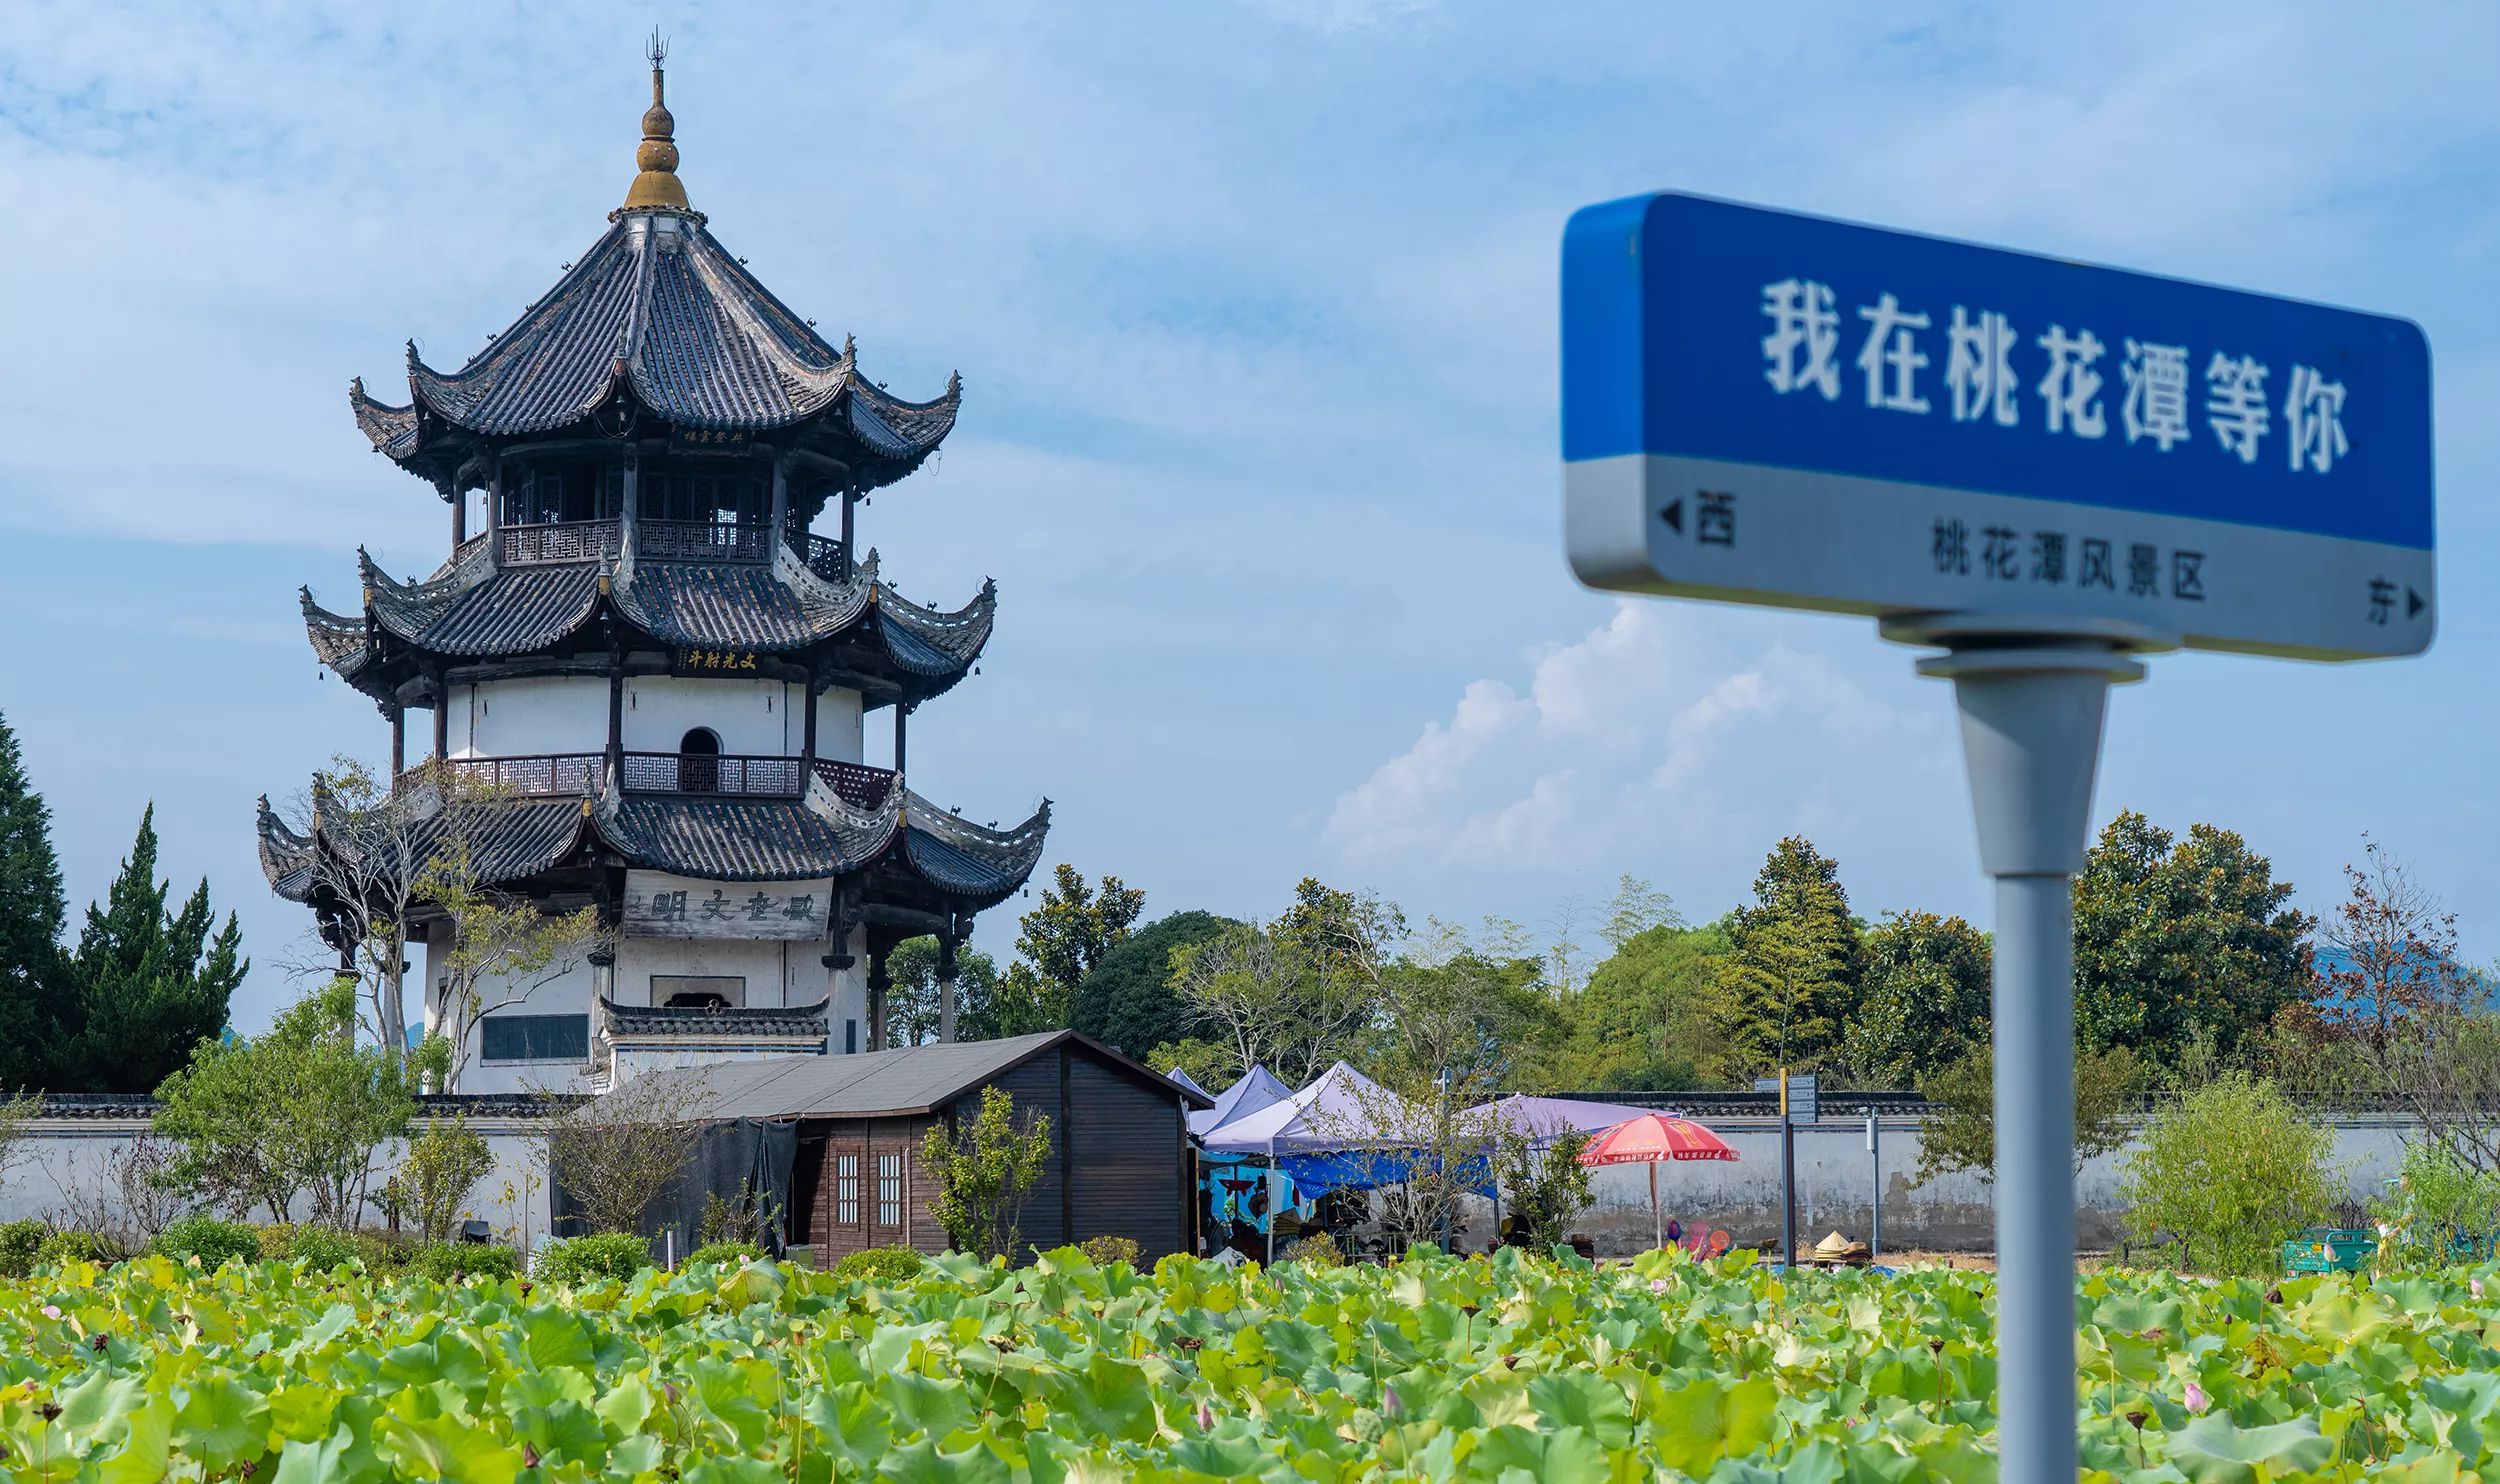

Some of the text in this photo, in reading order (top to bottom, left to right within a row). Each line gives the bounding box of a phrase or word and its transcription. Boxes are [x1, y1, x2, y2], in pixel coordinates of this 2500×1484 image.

[1760, 276, 2350, 474] 我在桃花潭等你
[1697, 490, 1736, 548] 西
[1931, 516, 2207, 601] 桃花潭风景区
[2367, 575, 2398, 627] 东
